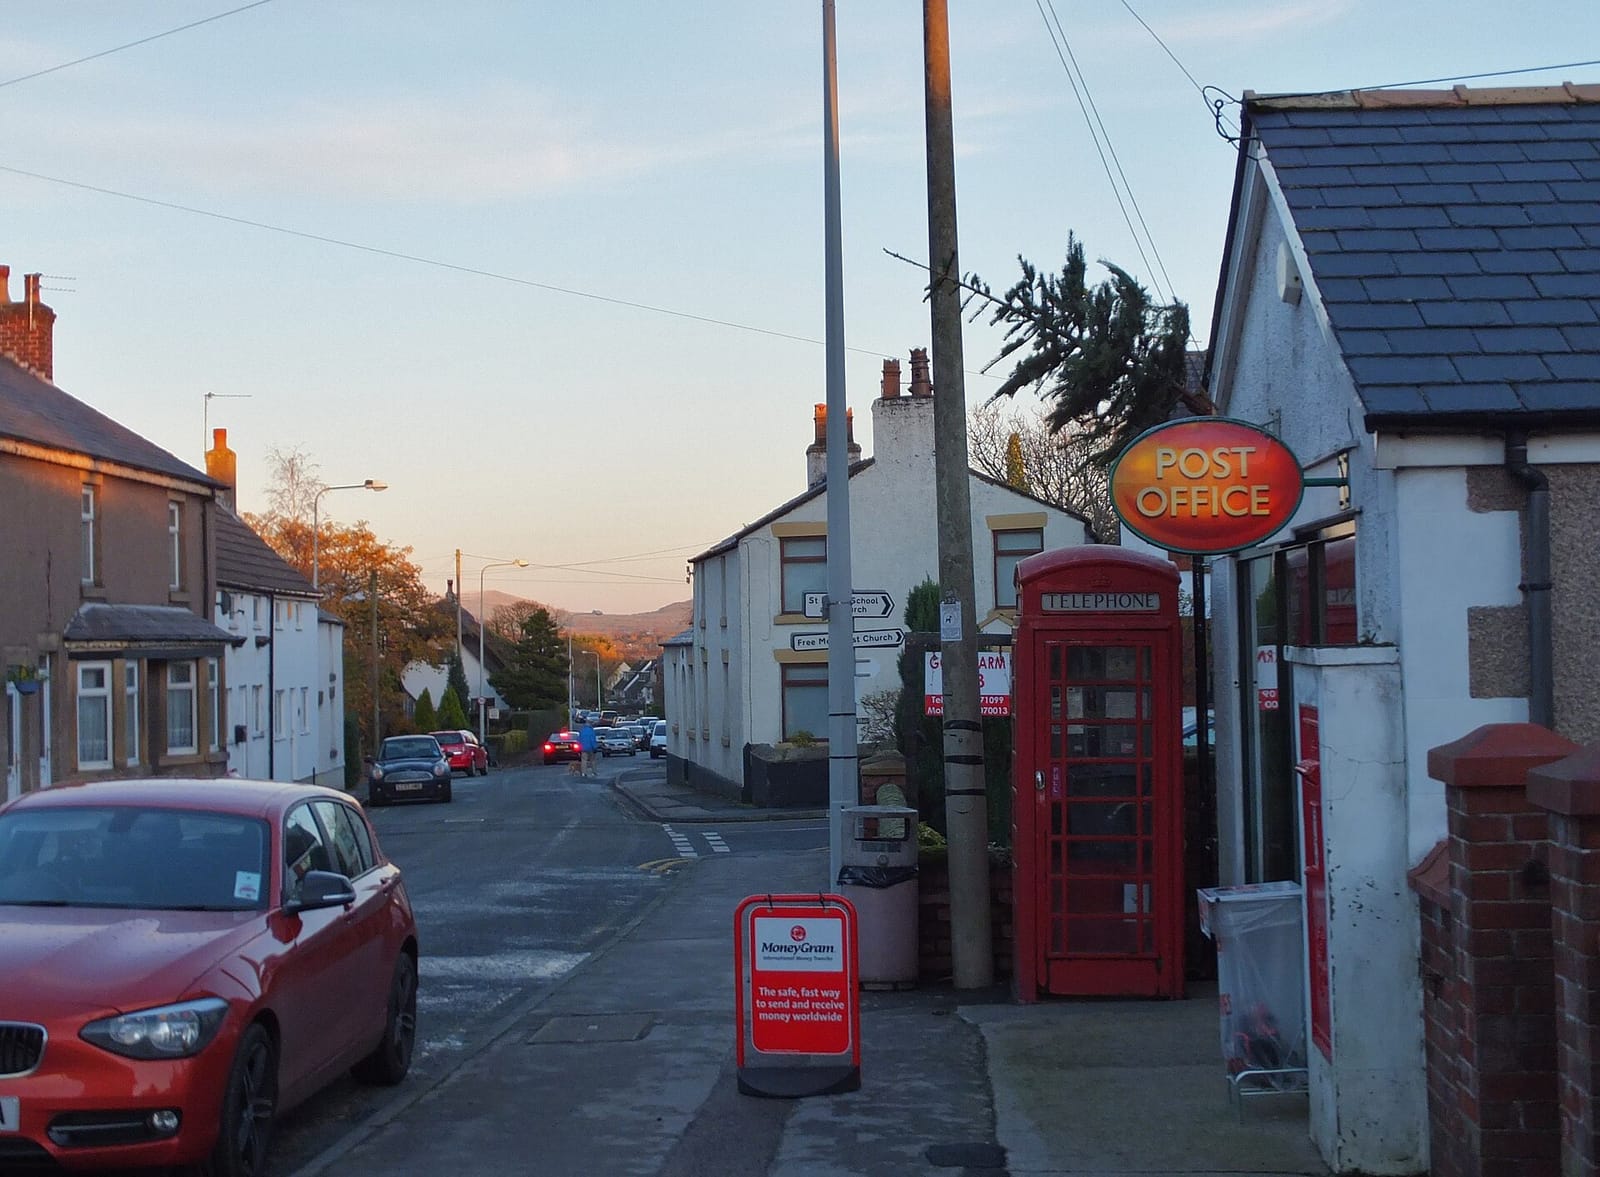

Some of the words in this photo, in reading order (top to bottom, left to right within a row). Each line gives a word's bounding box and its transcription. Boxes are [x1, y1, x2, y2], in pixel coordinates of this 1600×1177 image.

[1156, 447, 1256, 479] POST
[1136, 485, 1270, 517] OFFICE
[808, 596, 818, 604] St
[851, 596, 878, 604] School
[1049, 594, 1154, 609] TELEPHONE
[862, 633, 893, 642] Church
[978, 656, 1006, 669] ARM
[980, 696, 1004, 704] 71099
[980, 706, 1008, 715] 70013
[761, 942, 834, 955] MoneyGram
[759, 987, 776, 996] The
[778, 987, 800, 998] safe,
[800, 988, 819, 997] fast
[821, 990, 840, 999] way
[756, 999, 767, 1008] to
[768, 999, 790, 1009] send
[792, 1000, 810, 1009] and
[811, 1000, 845, 1010] receive
[759, 1012, 791, 1023] money
[792, 1012, 842, 1022] worldwide
